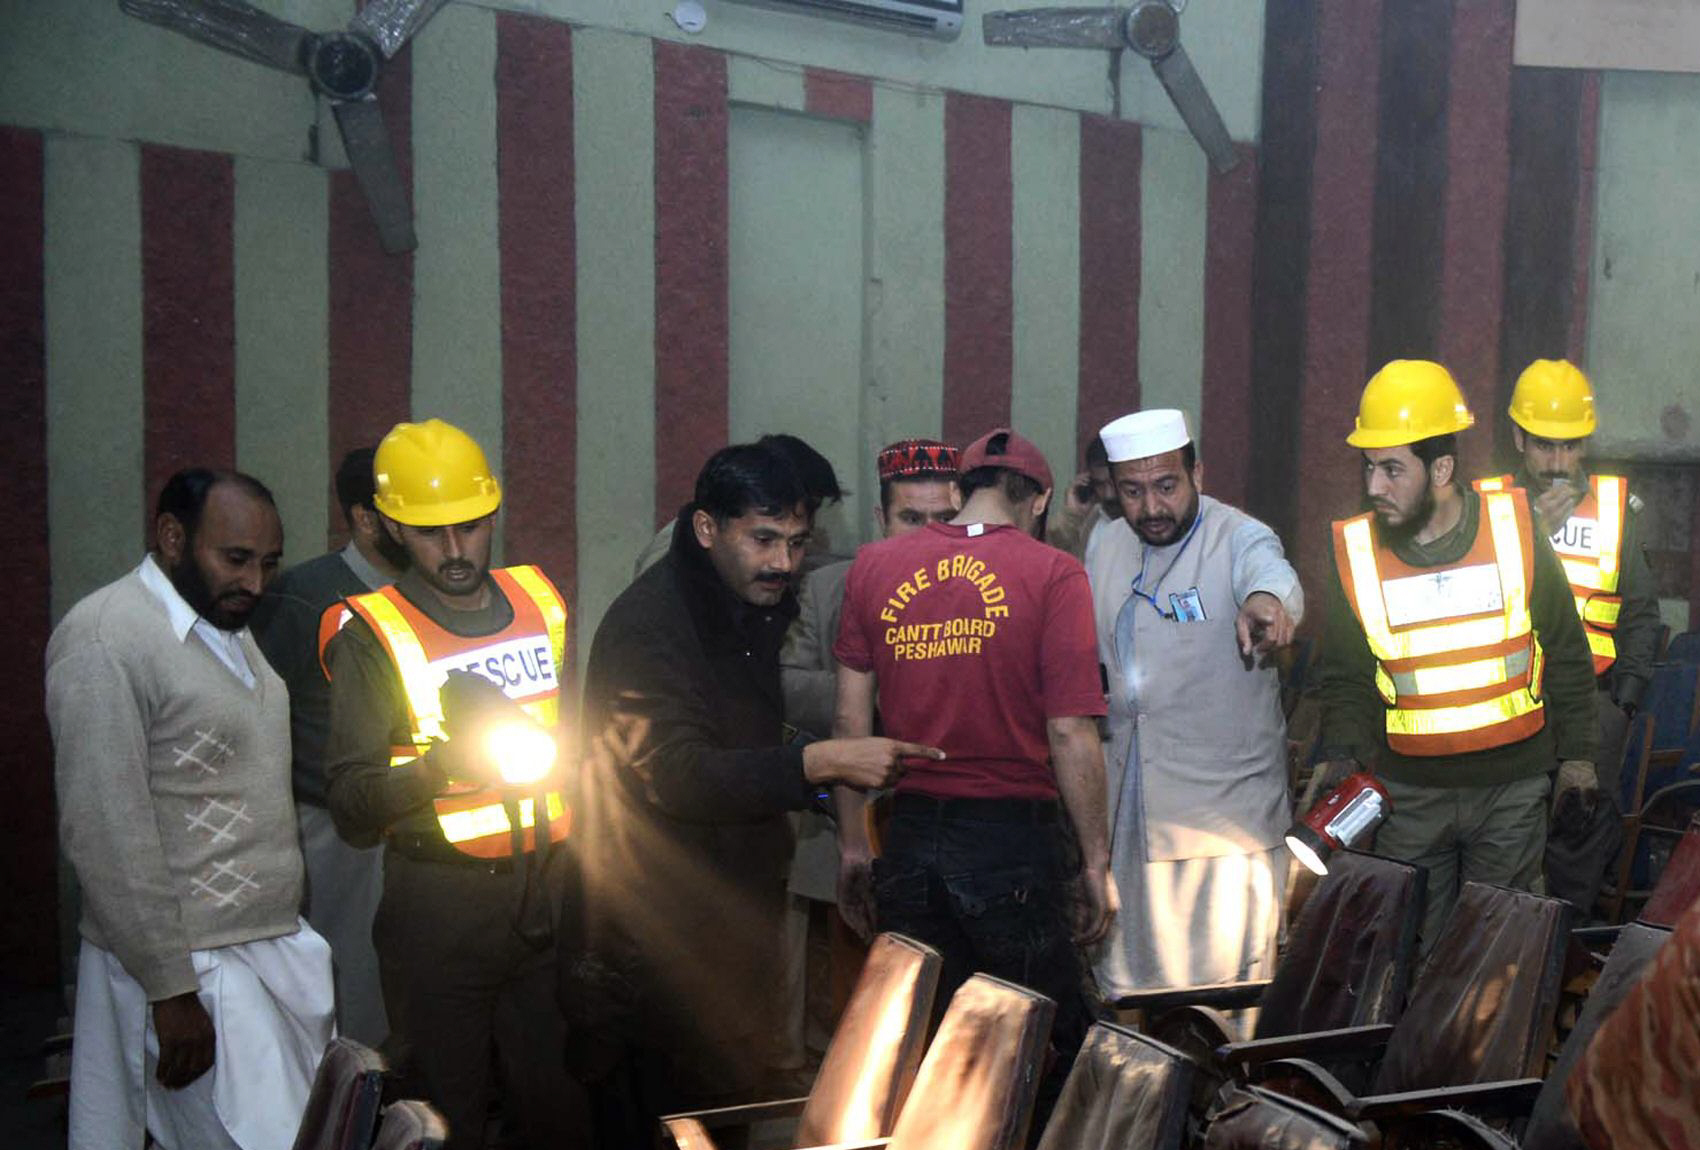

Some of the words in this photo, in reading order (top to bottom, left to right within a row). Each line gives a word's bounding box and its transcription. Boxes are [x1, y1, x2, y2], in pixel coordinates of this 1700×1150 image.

[880, 567, 931, 623] FIRE
[937, 554, 1009, 619] BRIGADE
[885, 623, 943, 645] CANTT
